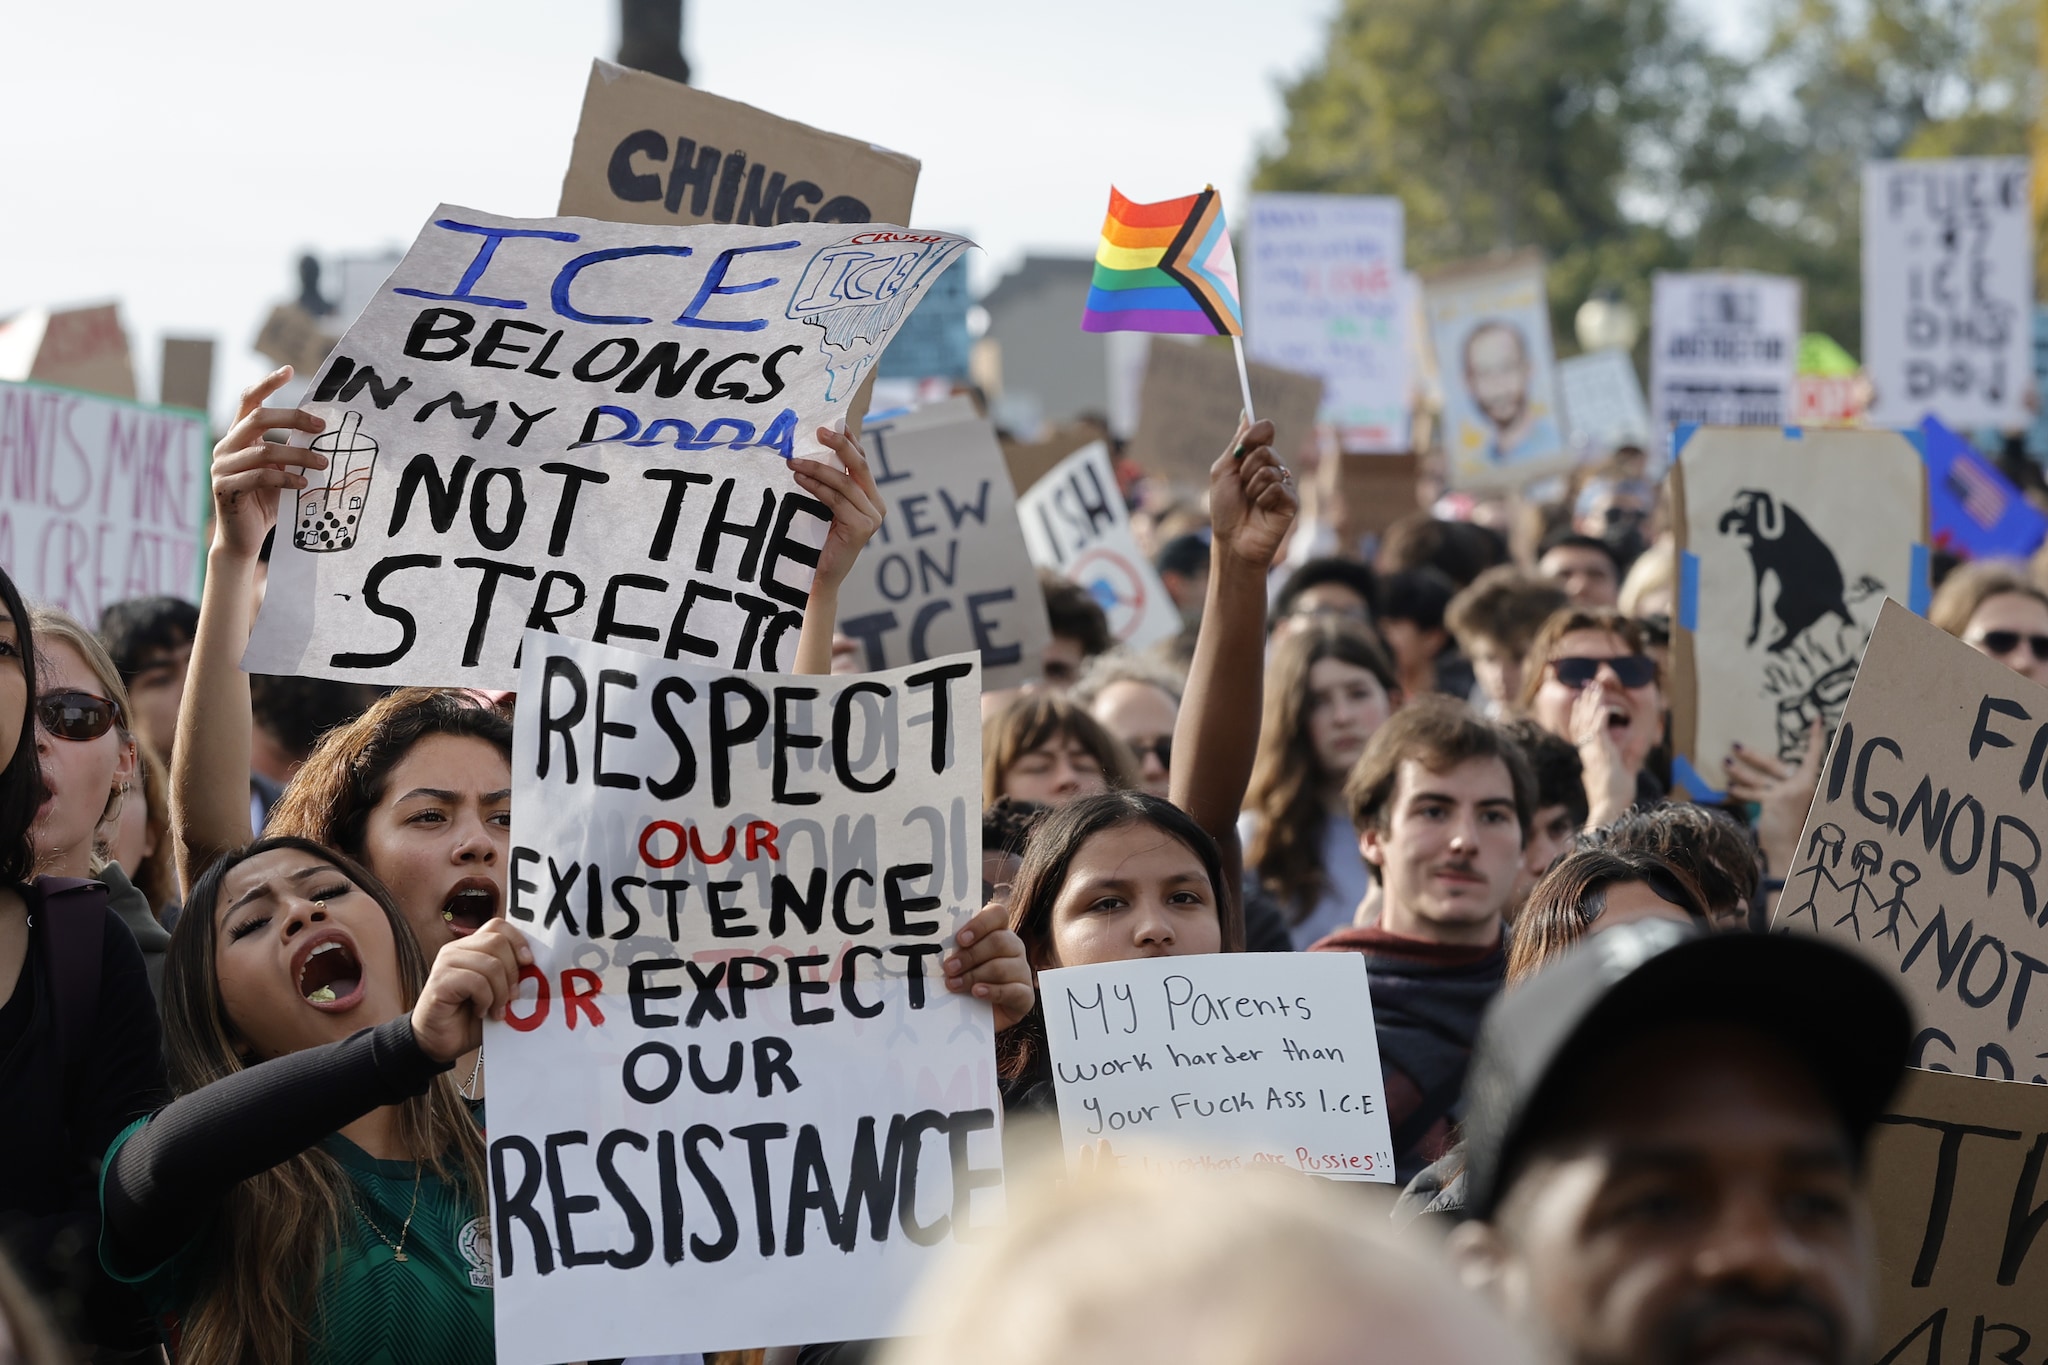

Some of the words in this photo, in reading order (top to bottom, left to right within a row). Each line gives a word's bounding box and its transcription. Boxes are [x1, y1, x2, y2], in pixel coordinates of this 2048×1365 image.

[393, 218, 801, 333] ICE
[852, 232, 942, 245] CRUSH
[313, 356, 413, 410] IN
[414, 391, 557, 447] MY
[403, 308, 803, 404] BELONGS
[388, 453, 610, 557] NOT
[643, 469, 834, 611] THE
[876, 540, 959, 602] ON
[840, 587, 1022, 672] ICE
[536, 655, 973, 807] RESPECT
[1969, 694, 2048, 797] FI
[638, 820, 780, 869] OUR
[1826, 721, 2048, 927] IGNOR
[509, 846, 941, 942] EXISTENCE
[502, 964, 605, 1032] OR
[627, 943, 942, 1029] EXPECT
[1163, 975, 1312, 1031] Parents
[1901, 903, 2048, 1033] NOT
[622, 1036, 802, 1104] OUR
[1057, 1053, 1152, 1085] work
[1166, 1044, 1263, 1068] harder
[1283, 1037, 1344, 1063] than
[1319, 1089, 1375, 1115] I.C.E
[490, 1108, 1002, 1279] RESISTANCE
